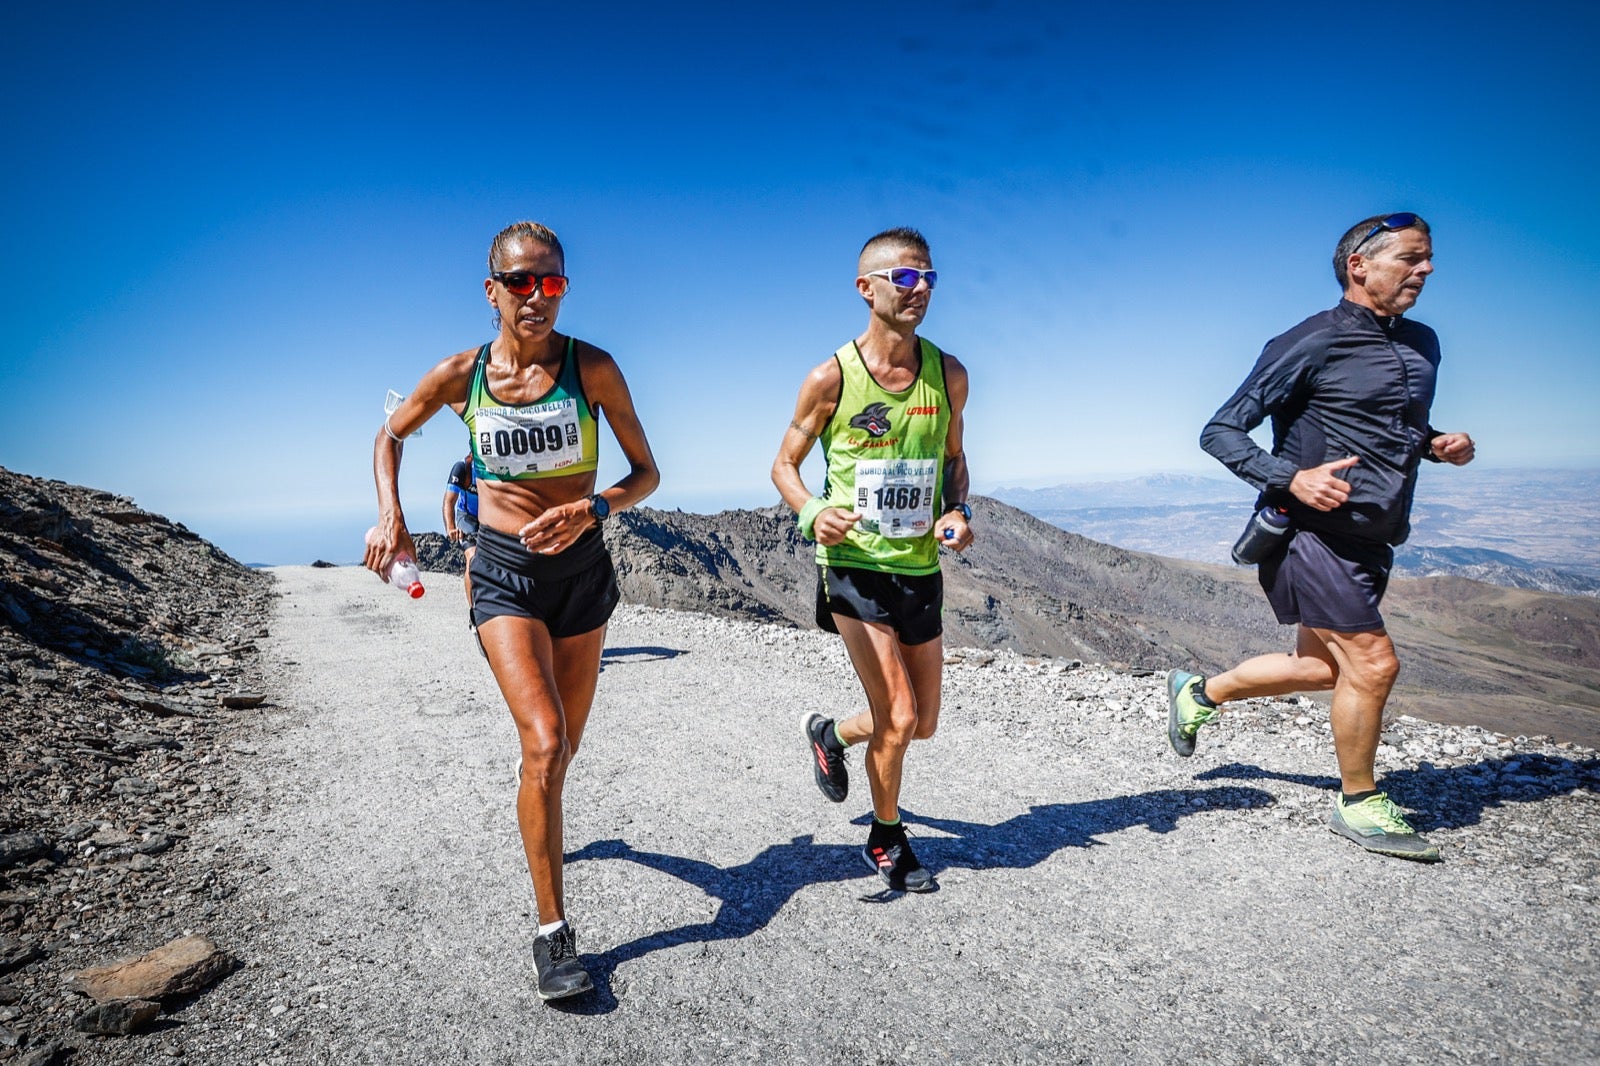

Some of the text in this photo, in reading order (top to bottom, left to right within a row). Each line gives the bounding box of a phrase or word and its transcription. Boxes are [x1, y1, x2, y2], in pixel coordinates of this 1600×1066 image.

[541, 399, 572, 413] VELETA
[495, 425, 563, 457] 0009
[860, 467, 887, 476] SUBIDA
[888, 467, 896, 476] AL
[897, 466, 913, 476] PICO
[873, 486, 921, 510] 1468
